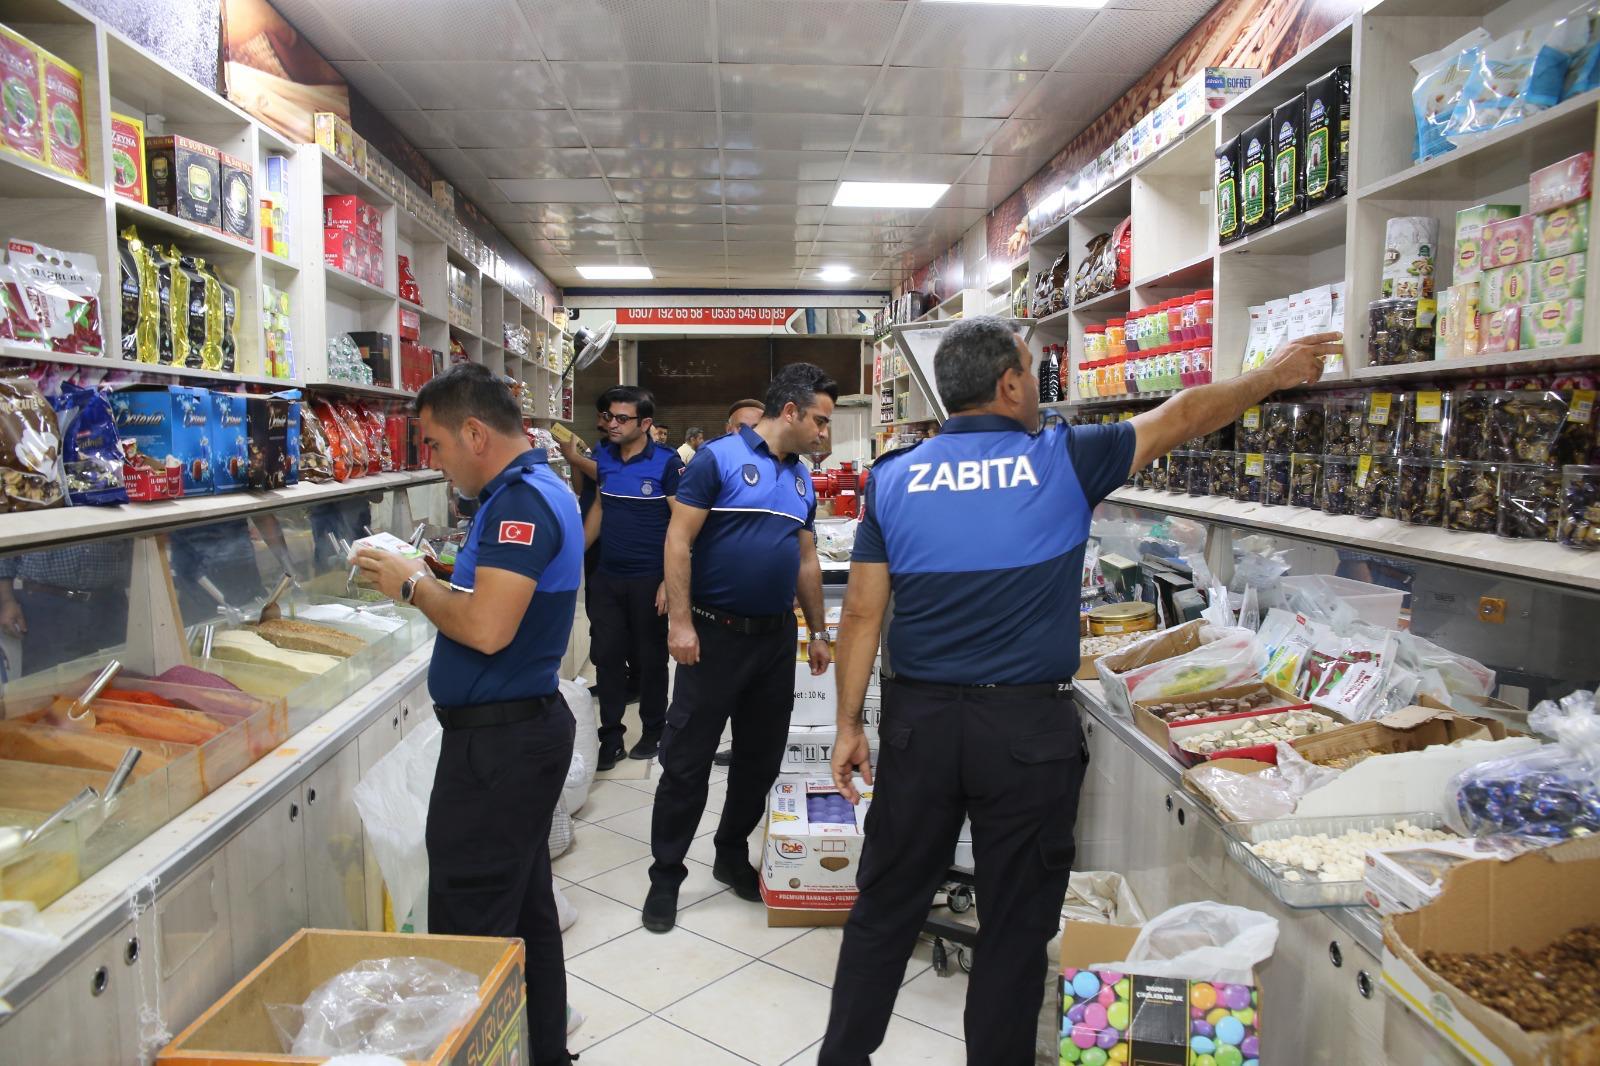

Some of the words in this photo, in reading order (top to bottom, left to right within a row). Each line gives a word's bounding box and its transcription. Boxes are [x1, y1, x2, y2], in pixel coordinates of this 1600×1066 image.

[908, 455, 1039, 493] ZABITA
[691, 605, 716, 620] ABITA
[808, 691, 816, 699] 10
[817, 691, 826, 700] Kg
